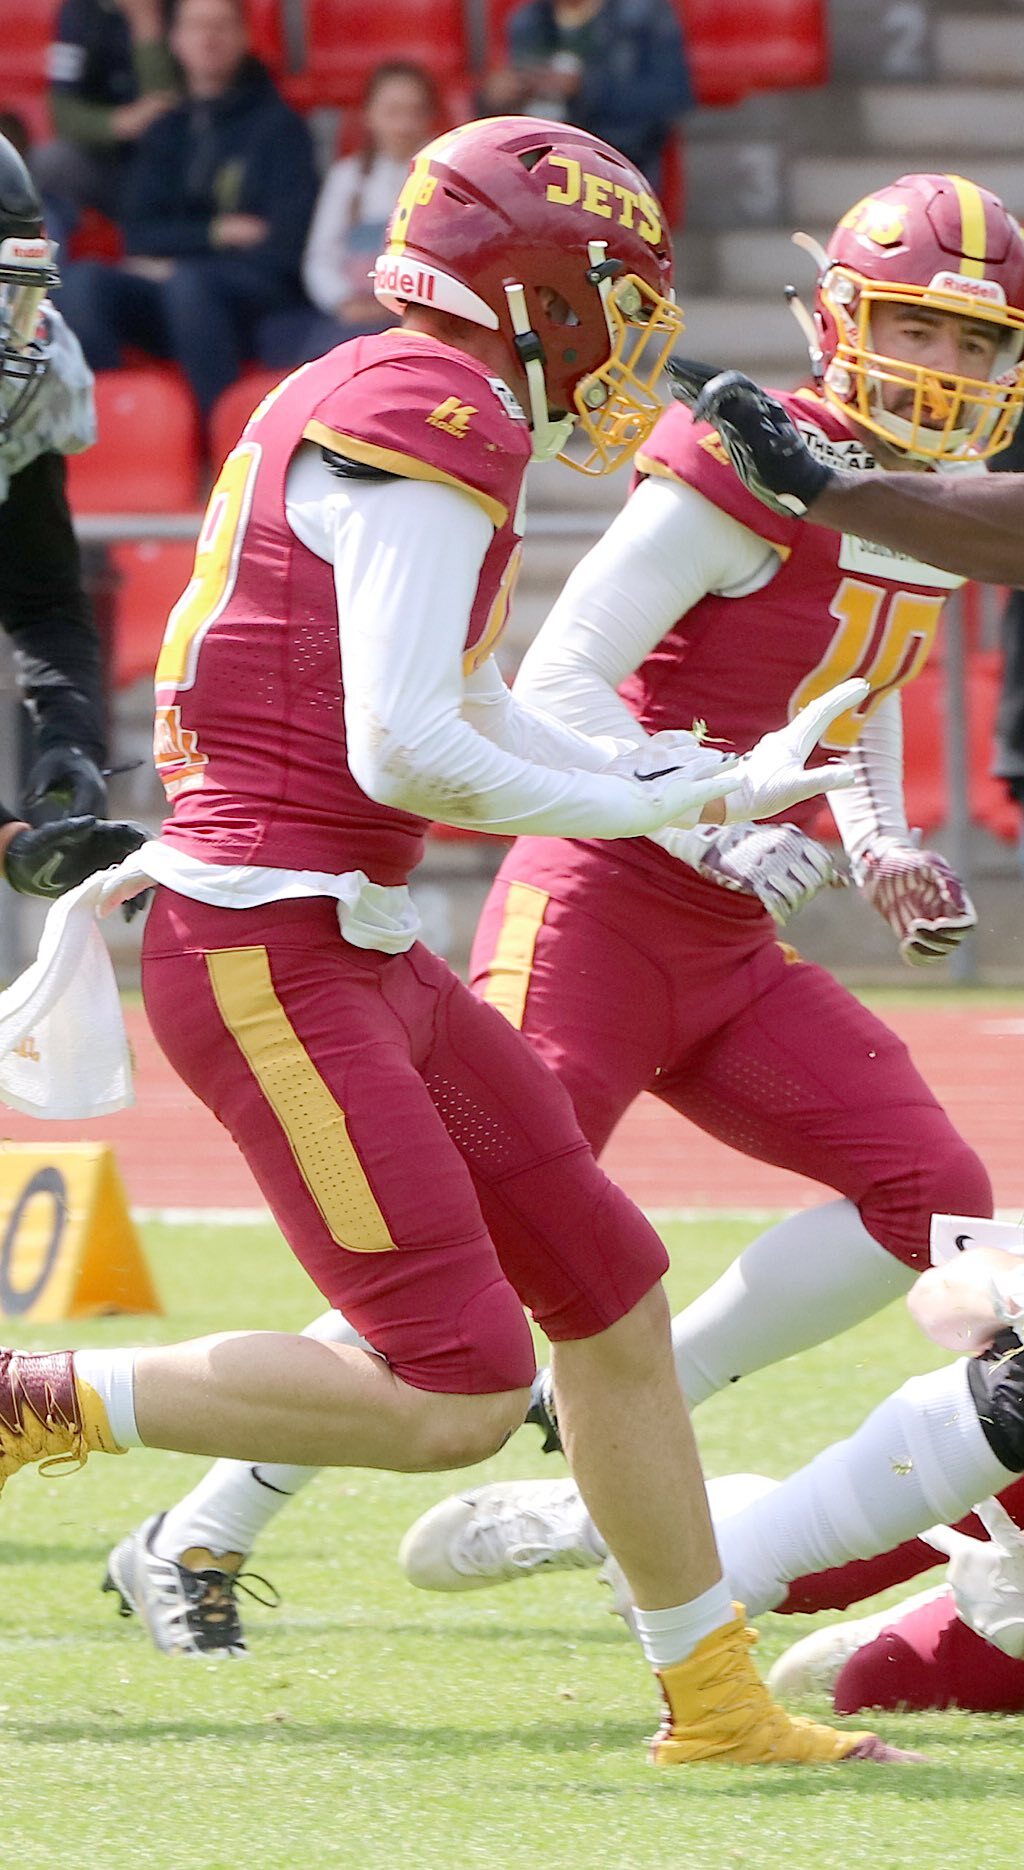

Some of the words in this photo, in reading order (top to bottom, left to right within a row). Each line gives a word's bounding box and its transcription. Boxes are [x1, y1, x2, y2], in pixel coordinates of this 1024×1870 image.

[880, 4, 926, 74] 2
[546, 155, 662, 246] JETS
[377, 263, 435, 301] ddell
[943, 278, 998, 298] Riddell
[788, 577, 946, 749] 10
